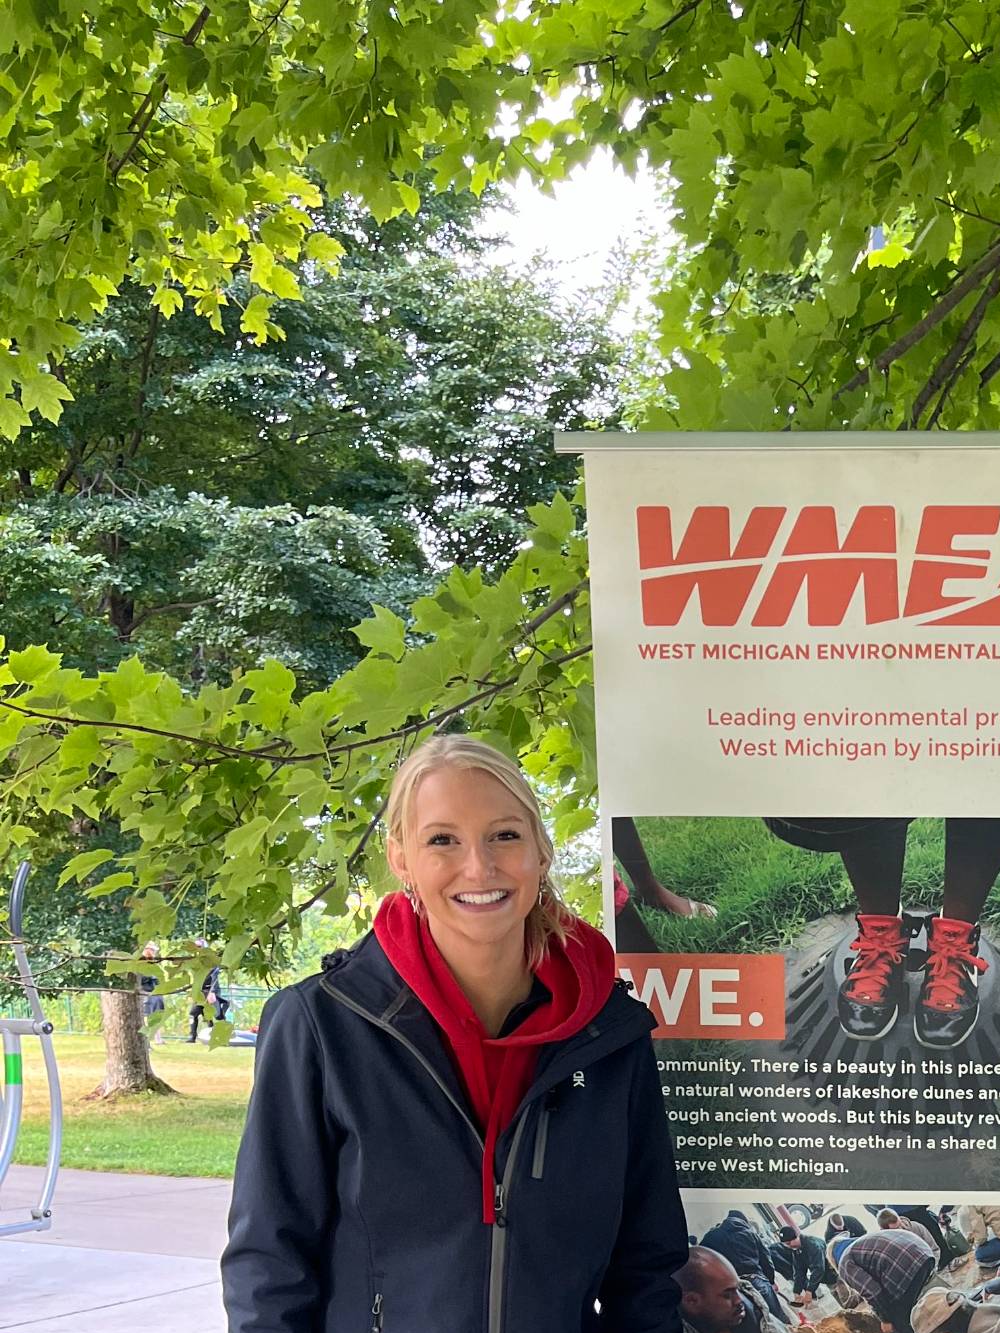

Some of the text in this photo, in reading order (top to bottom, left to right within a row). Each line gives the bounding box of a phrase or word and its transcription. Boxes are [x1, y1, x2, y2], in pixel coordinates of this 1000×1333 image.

[638, 643, 696, 660] WEST
[702, 643, 810, 660] MICHIGAN
[707, 708, 796, 731] Leading
[803, 708, 968, 726] environmental
[720, 738, 778, 756] West
[785, 738, 886, 761] Michigan
[895, 738, 921, 761] by
[618, 968, 764, 1027] WE.
[656, 1057, 746, 1075] ommunity.
[750, 1058, 799, 1072] There
[804, 1058, 817, 1073] is
[822, 1062, 831, 1073] a
[837, 1059, 896, 1077] beauty
[901, 1059, 916, 1074] in
[920, 1059, 952, 1074] this
[714, 1108, 777, 1122] ancient
[781, 1109, 841, 1123] woods.
[846, 1110, 875, 1124] But
[879, 1109, 910, 1124] this
[915, 1110, 974, 1128] beauty
[676, 1133, 733, 1150] people
[737, 1133, 773, 1147] who
[777, 1137, 824, 1148] come
[828, 1134, 902, 1151] together
[906, 1134, 921, 1149] in
[926, 1138, 935, 1149] a
[940, 1135, 996, 1150] shared
[720, 1158, 764, 1172] West
[769, 1158, 848, 1176] Michigan.
